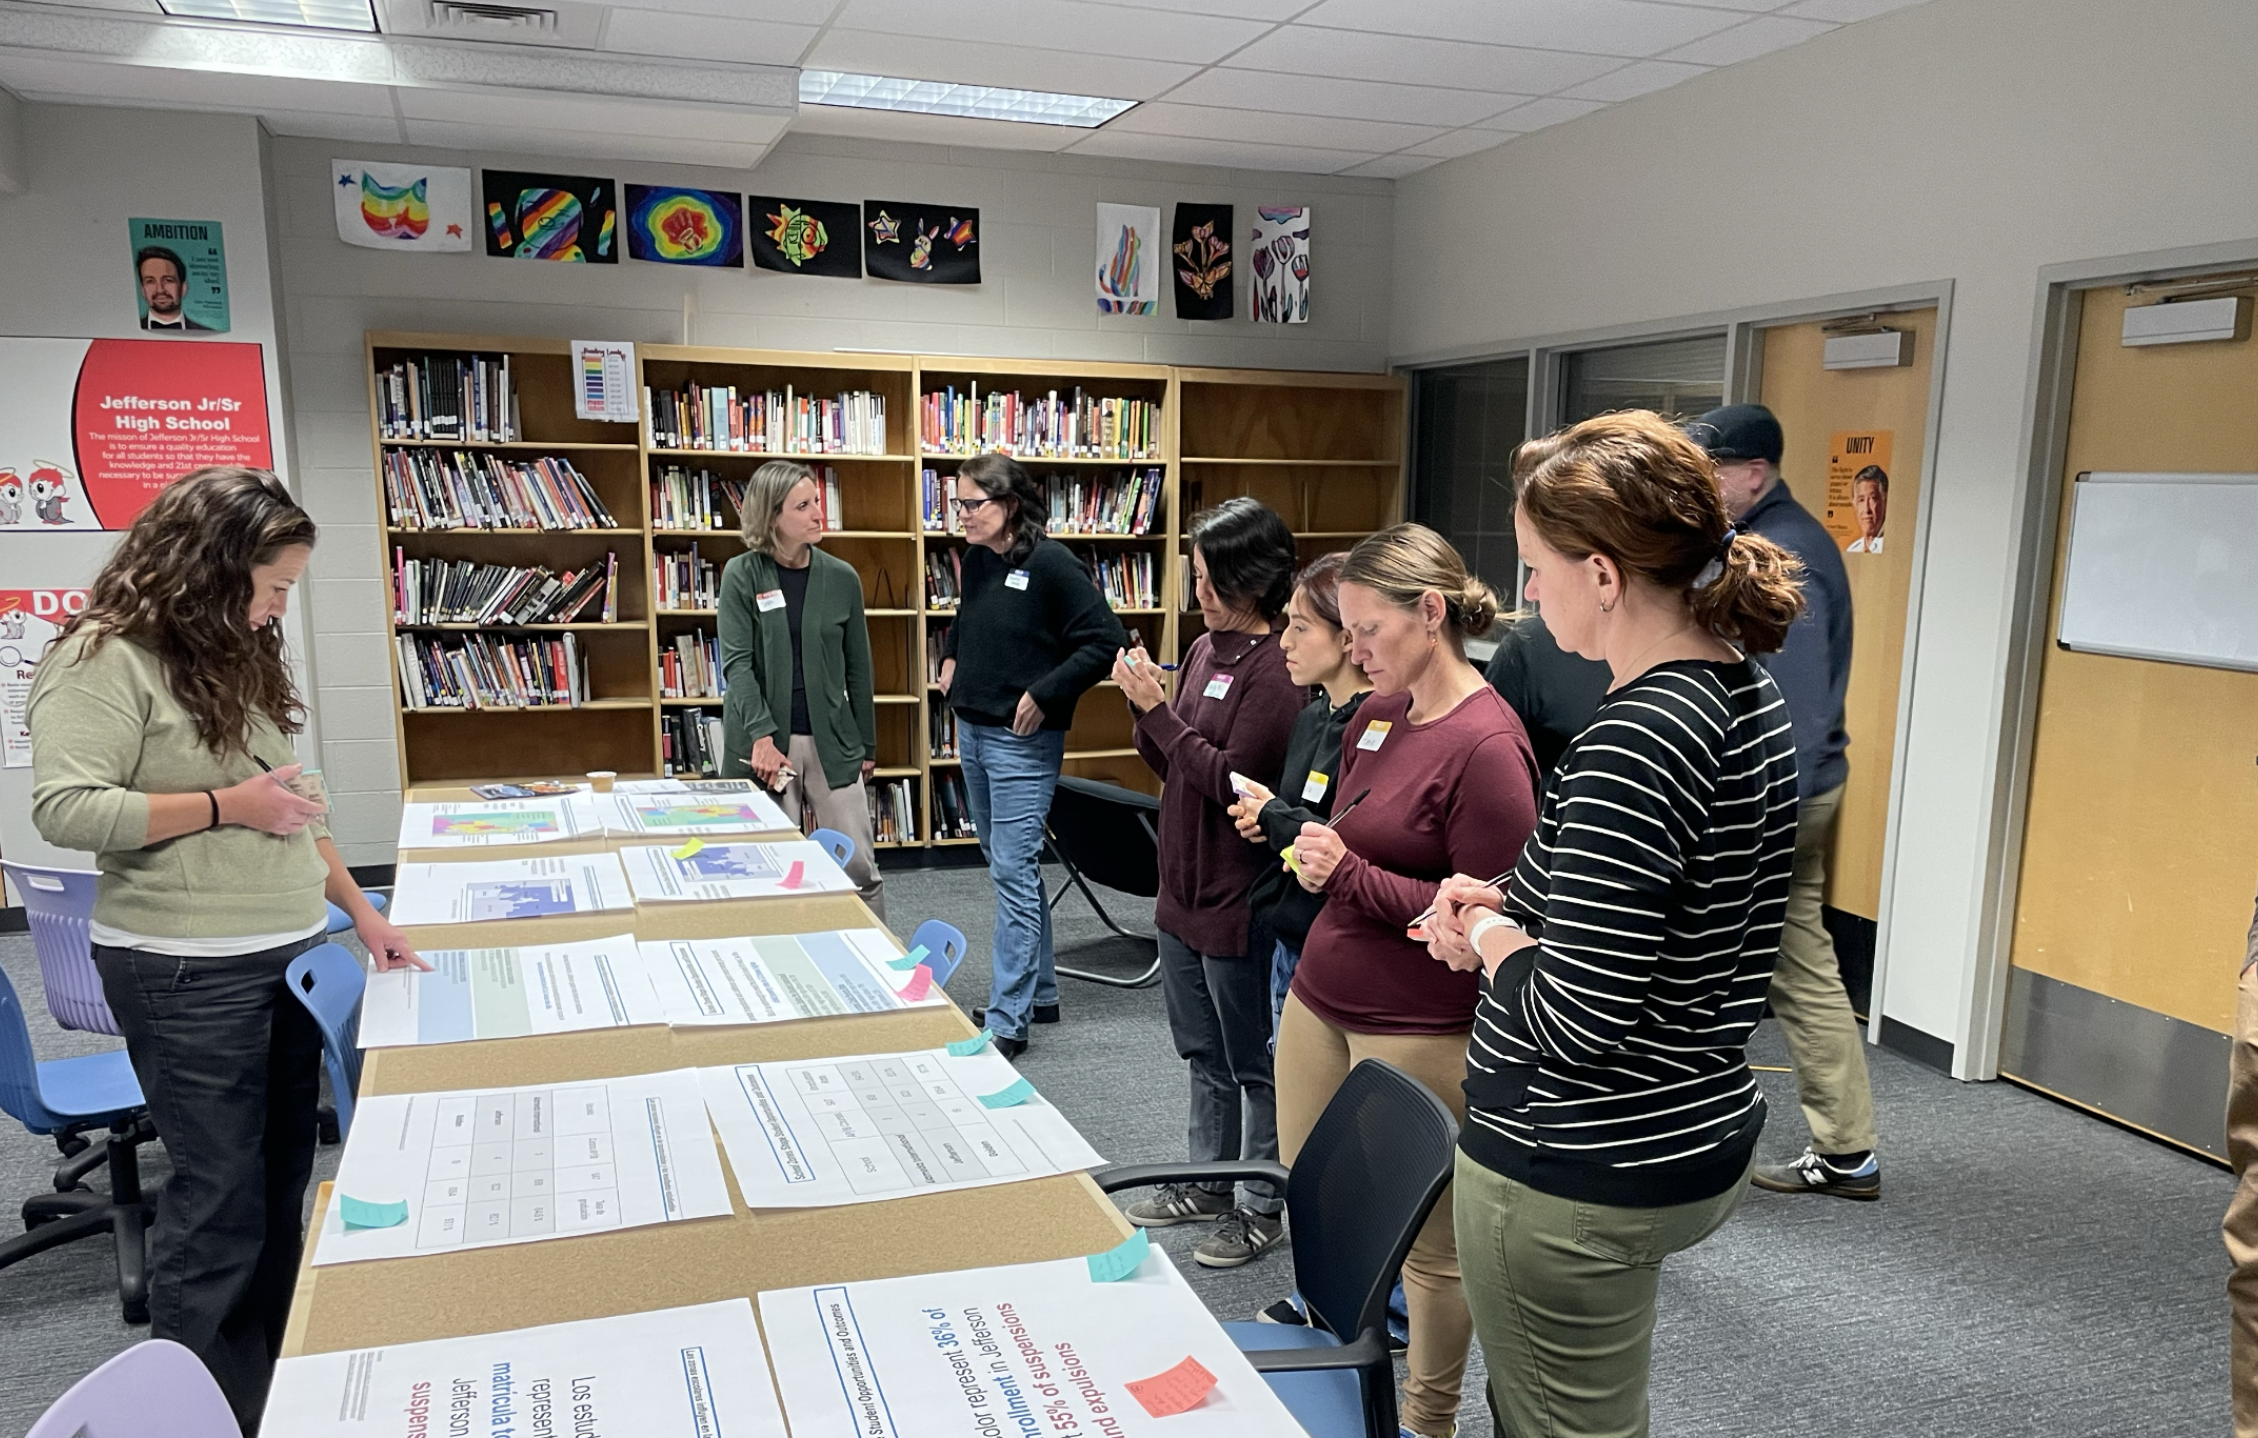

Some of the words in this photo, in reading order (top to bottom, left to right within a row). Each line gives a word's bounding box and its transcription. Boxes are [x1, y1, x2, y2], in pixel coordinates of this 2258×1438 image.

[145, 224, 208, 240] AMBITION
[100, 396, 191, 410] Jefferson
[197, 398, 241, 411] Jr/Sr
[116, 416, 160, 432] High
[166, 416, 230, 430] School
[89, 432, 106, 440] The
[138, 433, 147, 441] of
[150, 433, 187, 442] Jefferson
[189, 434, 208, 442] Jr/Sr
[210, 434, 230, 443] High
[1846, 437, 1874, 454] UNITY
[166, 443, 194, 452] quality
[109, 461, 155, 470] knowledge
[196, 453, 213, 462] they
[694, 723, 710, 753] Century
[776, 1136, 791, 1150] Shape
[895, 1133, 921, 1162] International
[783, 1150, 798, 1164] Zones
[940, 1142, 963, 1164] Jefferson
[790, 1164, 805, 1179] School
[858, 1156, 877, 1173] School
[829, 1304, 850, 1337] Outcomes
[922, 1308, 944, 1320] of
[929, 1322, 960, 1348] 36%
[963, 1307, 1001, 1358] Jefferson
[996, 1303, 1050, 1379] suspensions
[841, 1338, 856, 1351] and
[684, 1350, 696, 1359] Las
[686, 1359, 698, 1375] zonas
[846, 1352, 875, 1401] Opportunities
[987, 1361, 1009, 1373] in
[943, 1349, 987, 1408] represent
[1054, 1342, 1108, 1413] expulsions
[492, 1362, 518, 1426] matrícula
[572, 1376, 596, 1401] Los
[690, 1376, 705, 1401] escolares
[1032, 1383, 1059, 1396] of
[450, 1378, 477, 1437] Jefferson
[693, 1402, 711, 1423] influyen
[1043, 1400, 1078, 1430] 55%
[862, 1403, 884, 1435] Student
[975, 1413, 1004, 1438] olor
